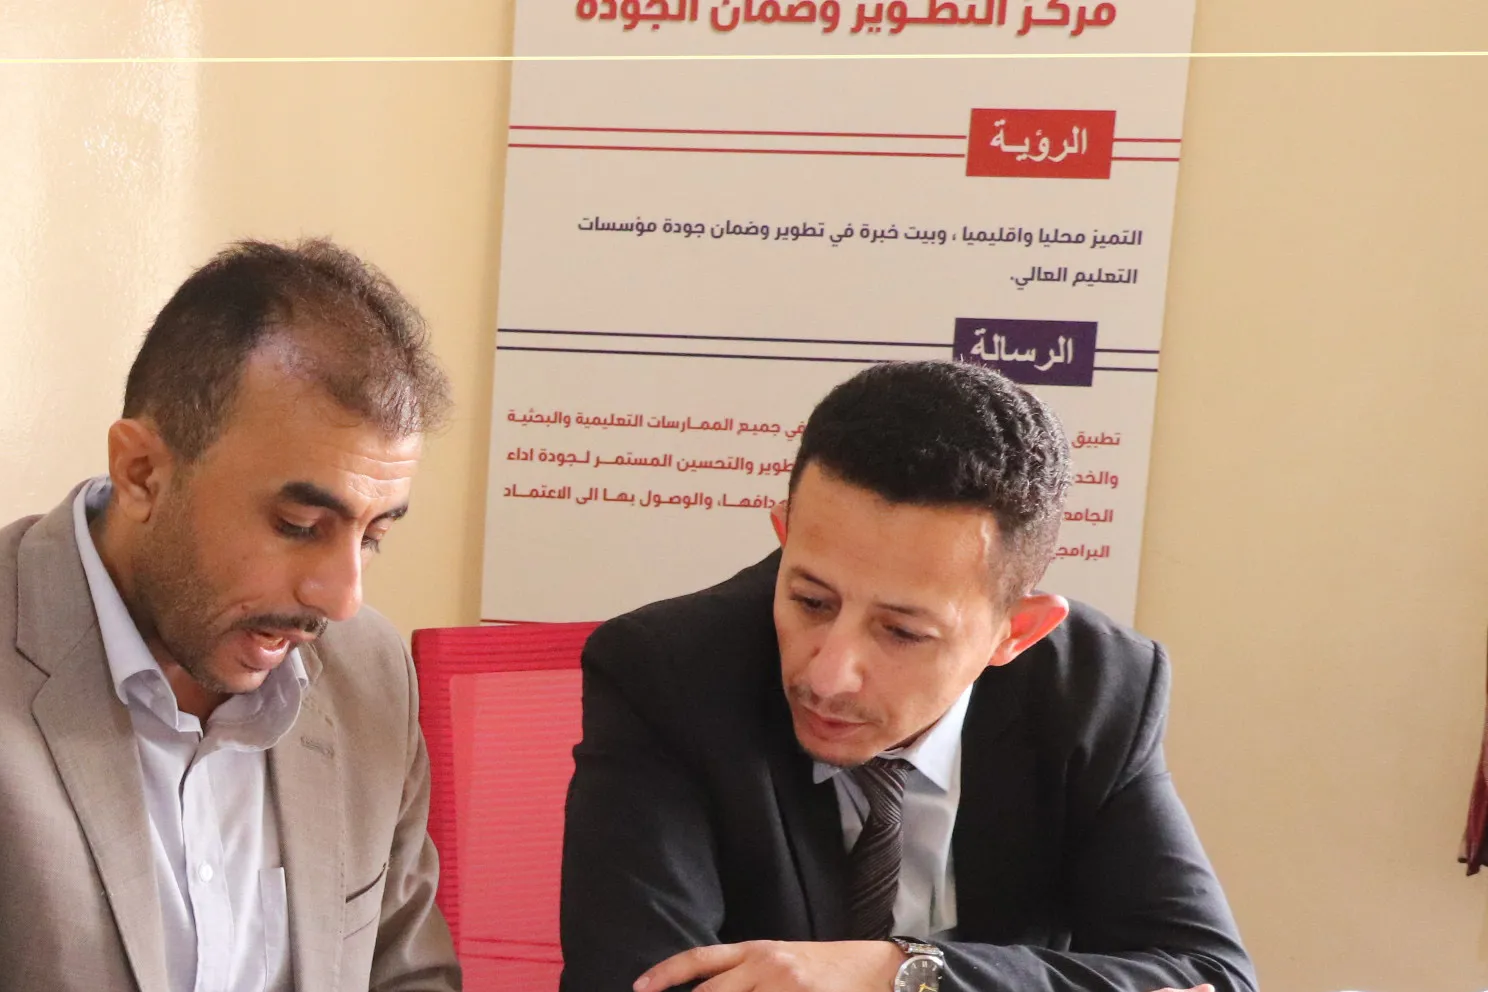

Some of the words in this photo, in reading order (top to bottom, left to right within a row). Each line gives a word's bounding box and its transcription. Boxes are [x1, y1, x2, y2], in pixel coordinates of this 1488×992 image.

[711, 0, 840, 34] وضمان
[1016, 0, 1116, 37] مركز
[990, 119, 1088, 162] الرؤية
[578, 216, 657, 236] مؤسسات
[663, 218, 705, 238] جودة
[711, 220, 770, 240] وضمان
[774, 222, 825, 240] تطوير
[829, 222, 854, 248] في
[860, 223, 899, 244] خبرة
[904, 226, 947, 245] وبيت
[962, 226, 1033, 247] واقليميا
[1038, 228, 1086, 247] محليا
[1090, 229, 1142, 249] التميز
[1010, 266, 1068, 291] العالي.
[1072, 268, 1138, 287] التعليم
[970, 328, 1073, 372] الرسالة
[507, 407, 571, 428] والبحثية
[575, 412, 643, 430] التعليمية
[647, 415, 733, 433] الممارسات
[737, 419, 780, 437] جميع
[785, 421, 807, 441] في
[1071, 431, 1121, 449] تطبيق
[507, 448, 534, 462] اداء
[539, 449, 590, 467] لجودة
[594, 453, 672, 468] المستمر
[677, 455, 754, 475] والتحسين
[1074, 470, 1119, 489] والخد
[503, 485, 571, 500] الاعتماد
[576, 486, 598, 504] الى
[603, 488, 635, 506] بها
[639, 490, 713, 509] والوصول
